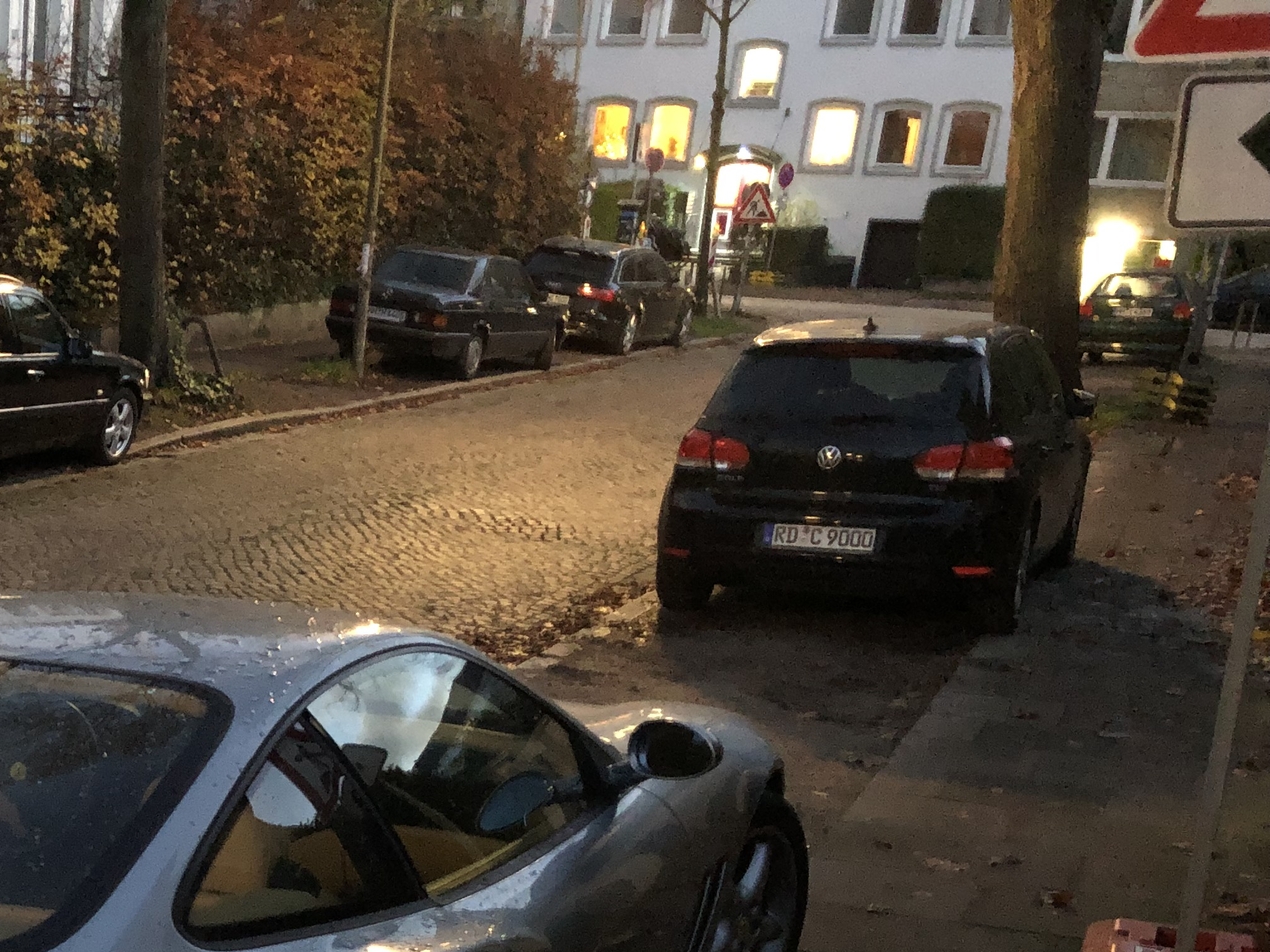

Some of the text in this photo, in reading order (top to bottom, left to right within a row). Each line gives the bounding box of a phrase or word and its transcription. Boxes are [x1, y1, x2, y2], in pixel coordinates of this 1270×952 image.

[774, 525, 874, 548] RD C 9000
